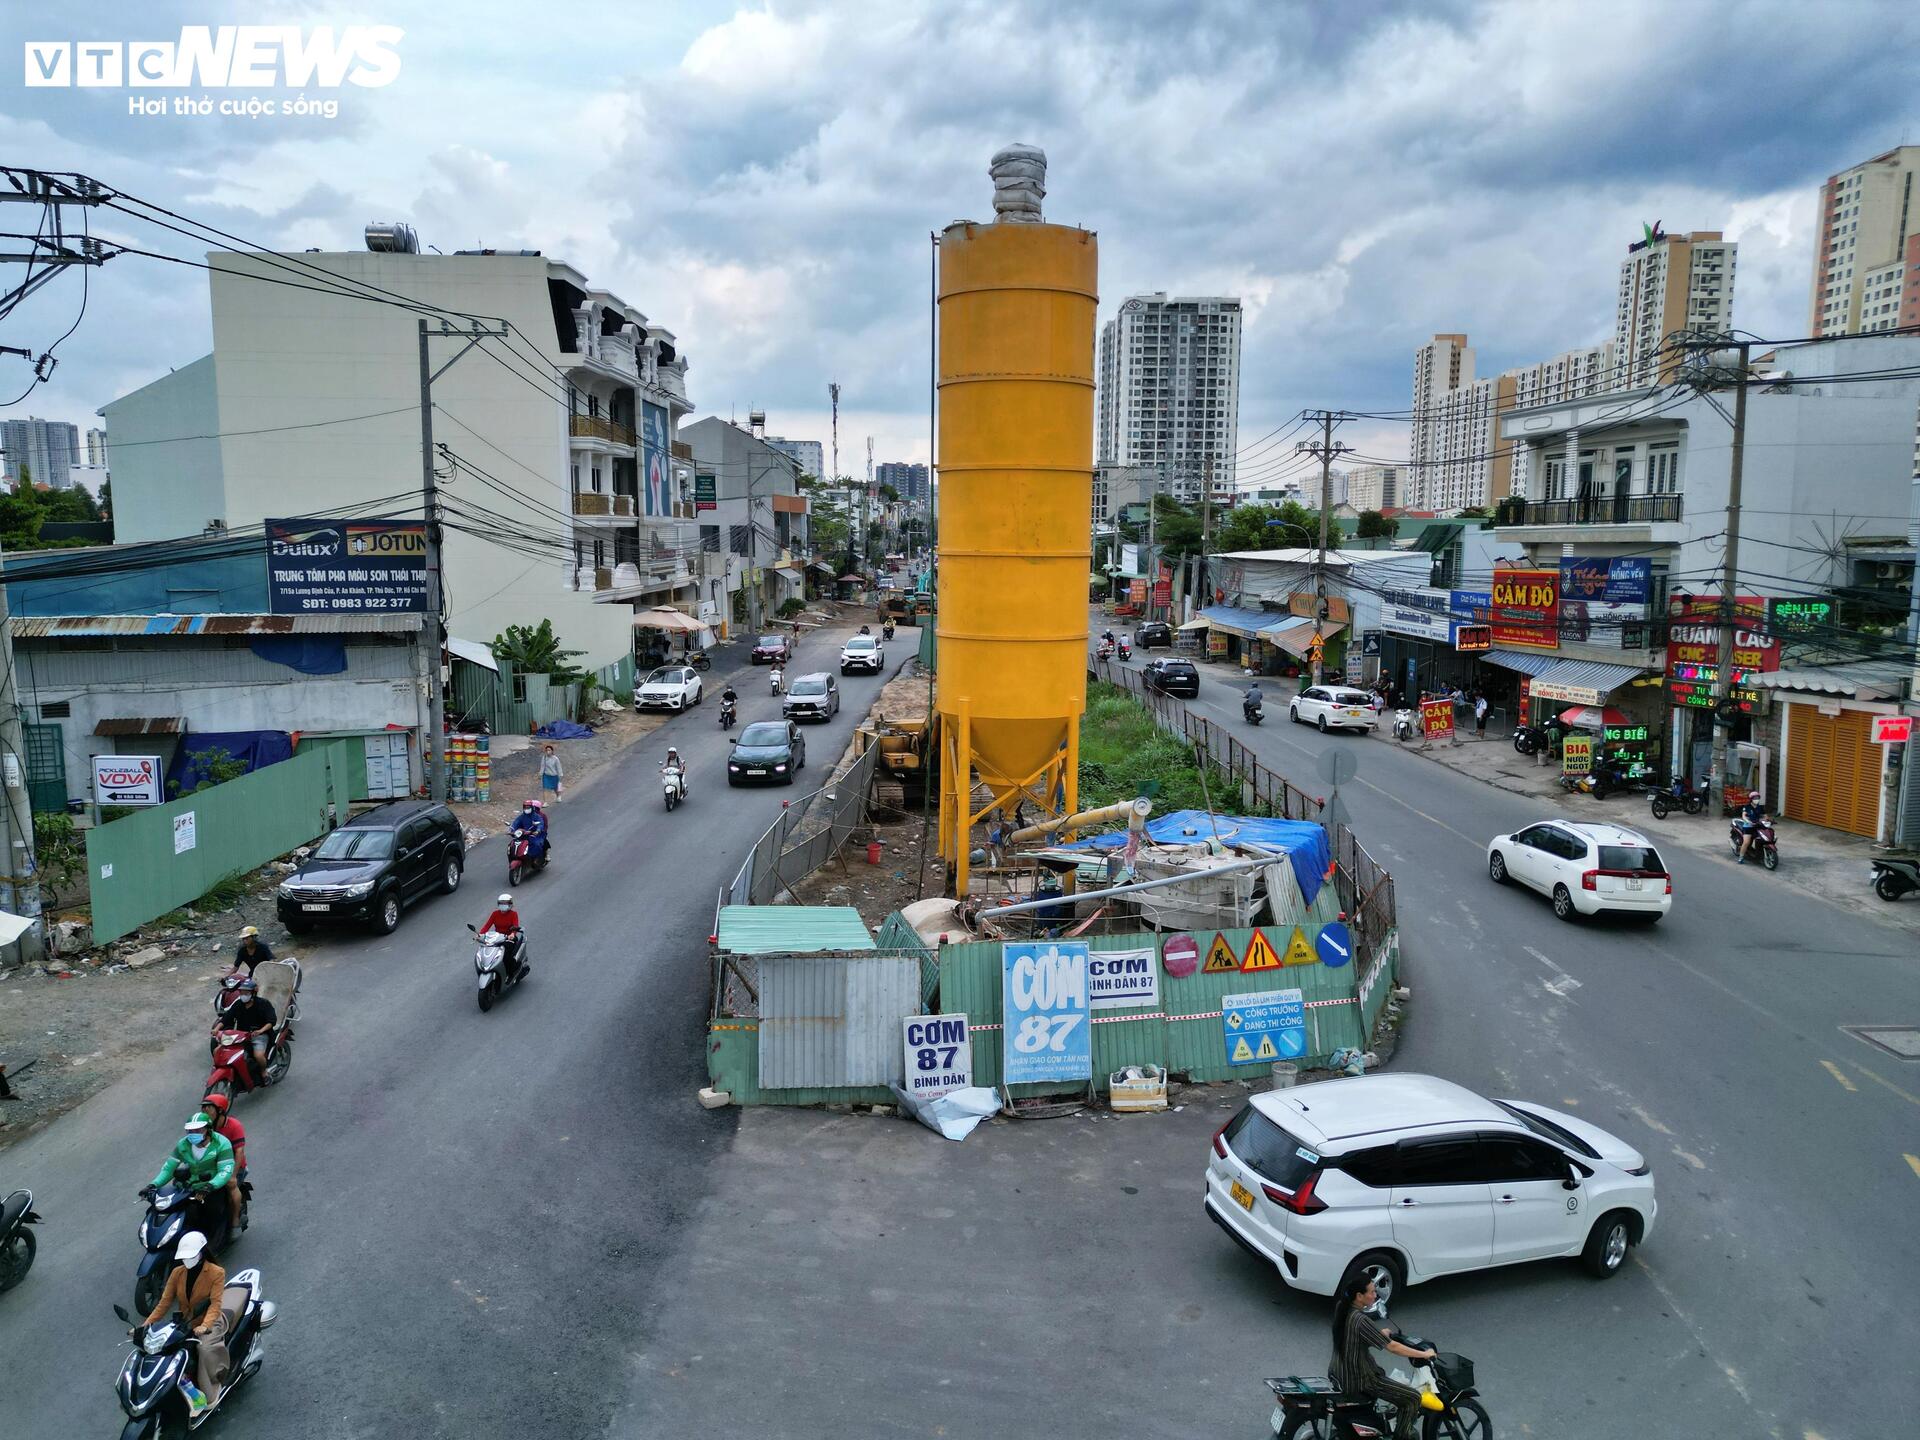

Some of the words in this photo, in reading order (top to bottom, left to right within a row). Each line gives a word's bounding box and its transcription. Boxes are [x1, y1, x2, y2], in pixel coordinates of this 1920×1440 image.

[274, 570, 304, 582] TRUNG
[307, 568, 326, 582] TÂM
[329, 570, 345, 582] PHA
[348, 568, 367, 582] MÀU
[391, 568, 408, 582] THÁI
[302, 598, 329, 609] SĐT:
[332, 599, 361, 608] 0983
[365, 598, 387, 608] 922
[391, 598, 411, 608] 377
[1678, 646, 1706, 660] CNC
[1566, 744, 1589, 754] BIA
[100, 773, 151, 784] VOVA
[1090, 958, 1148, 975] CƠM
[1012, 946, 1086, 1011] CƠM
[1115, 975, 1137, 989] DÂN
[1141, 977, 1153, 987] 87
[1245, 1007, 1267, 1017] CÔNG
[1269, 1003, 1300, 1014] TRƯỜNG
[1245, 1021, 1266, 1030] ĐANG
[1268, 1019, 1279, 1027] THI
[1280, 1015, 1302, 1026] CÔNG
[908, 1020, 965, 1046] CƠM
[1014, 1014, 1084, 1053] 87
[917, 1046, 958, 1070] 87
[914, 1075, 940, 1088] BÌNH
[943, 1072, 965, 1085] DÂN
